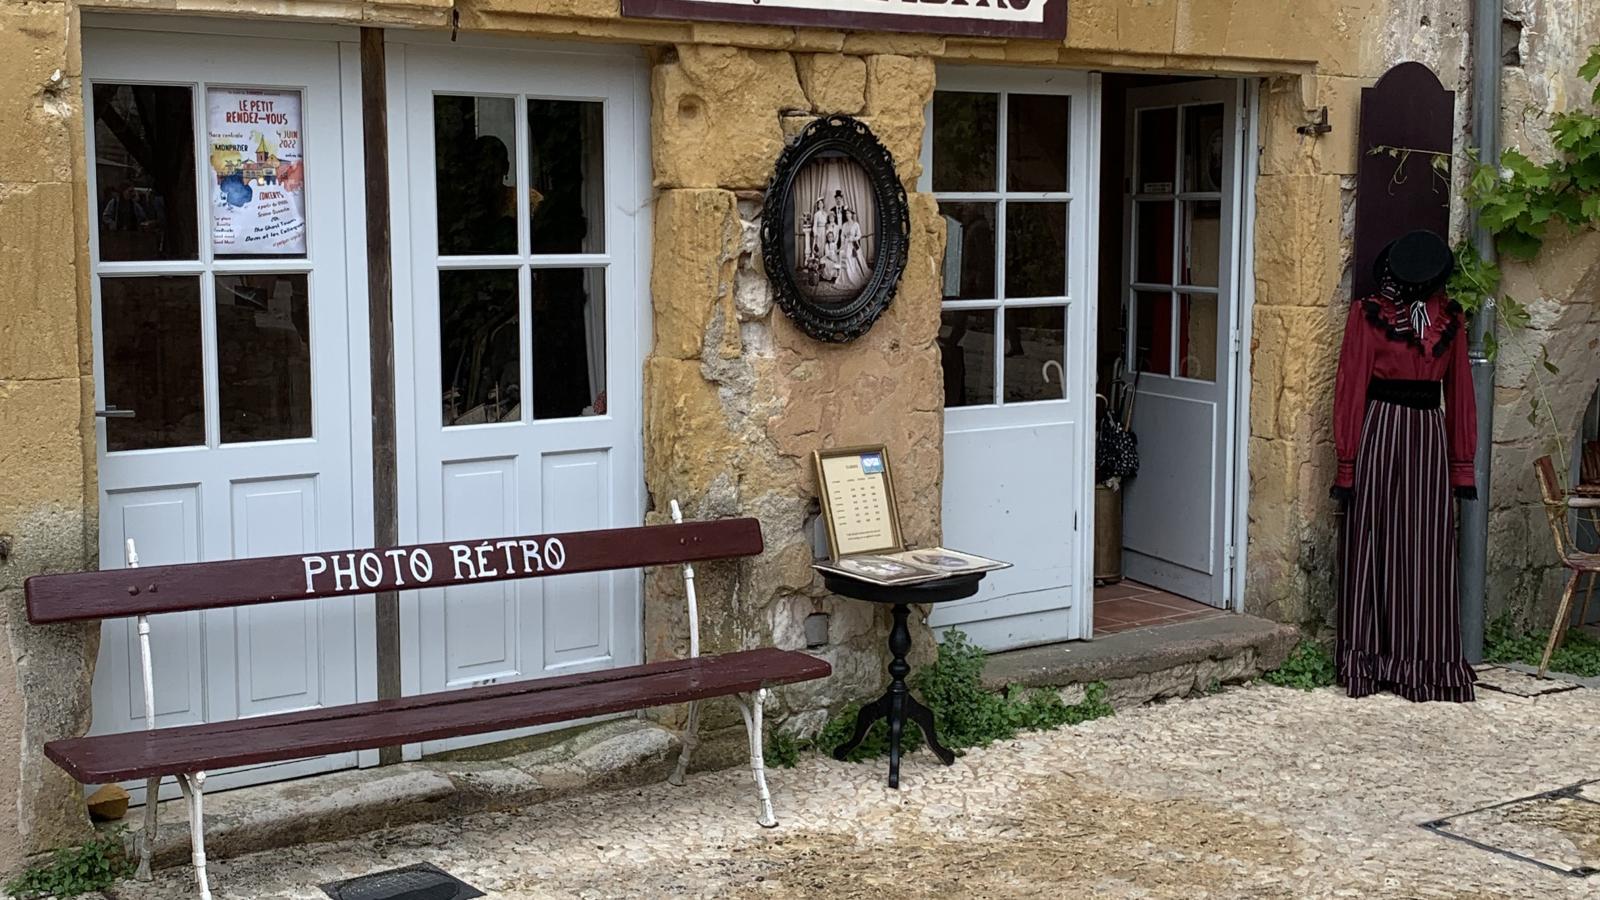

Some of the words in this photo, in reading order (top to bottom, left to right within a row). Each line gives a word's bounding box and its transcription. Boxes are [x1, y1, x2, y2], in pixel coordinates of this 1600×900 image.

[239, 100, 248, 111] LE
[250, 101, 273, 112] PETIT
[284, 131, 299, 139] JUIN
[215, 144, 248, 152] MONPAZIER
[279, 139, 297, 148] 2022
[302, 548, 433, 593] PHOTO
[449, 537, 566, 580] RÉTRO
